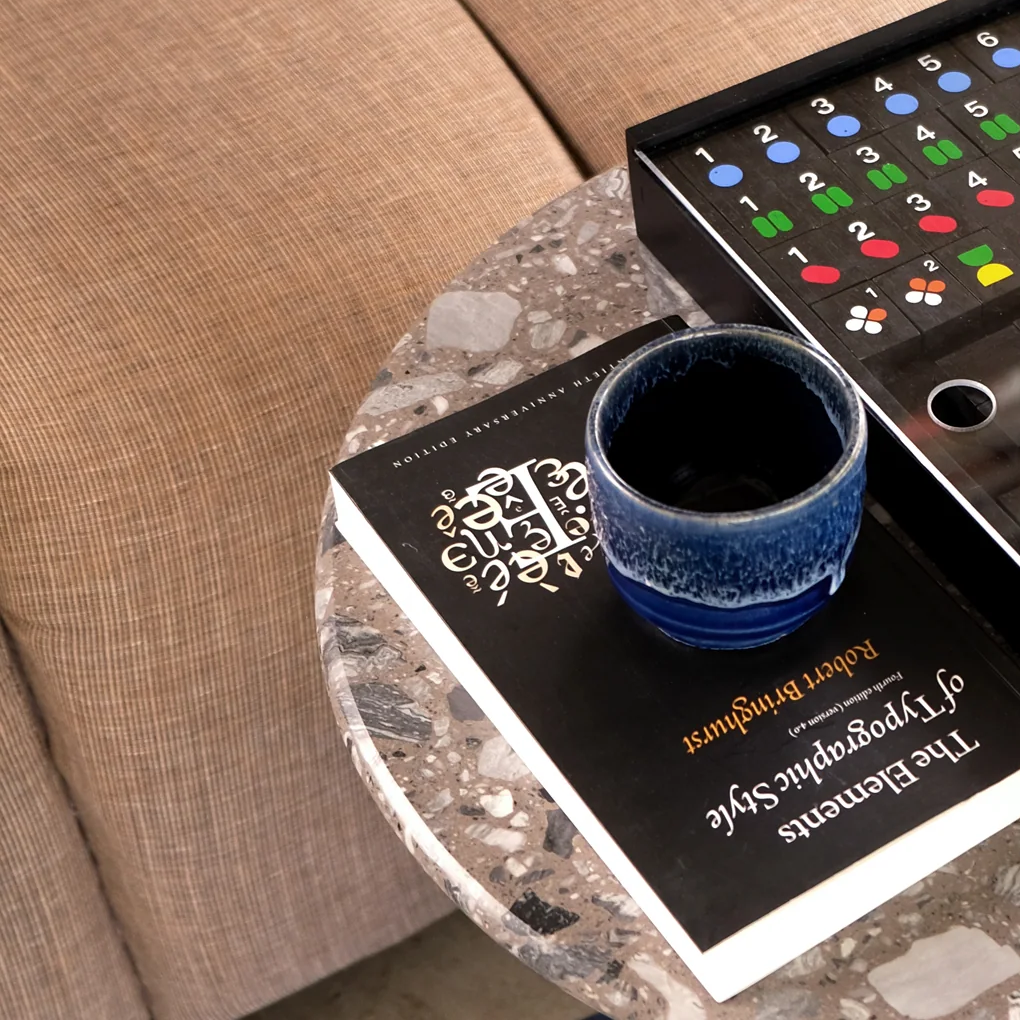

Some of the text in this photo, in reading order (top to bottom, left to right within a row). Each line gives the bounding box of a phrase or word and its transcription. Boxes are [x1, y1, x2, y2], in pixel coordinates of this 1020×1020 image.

[976, 31, 999, 48] 6
[917, 54, 942, 72] 5
[874, 76, 894, 93] 4
[810, 97, 835, 115] 3
[963, 99, 989, 118] 5
[753, 124, 779, 144] 2
[916, 124, 936, 142] 4
[695, 147, 715, 163] 1
[855, 145, 881, 164] 3
[798, 171, 826, 192] 2
[968, 170, 988, 188] 4
[739, 195, 759, 212] 1
[906, 193, 932, 212] 3
[847, 220, 876, 242] 2
[787, 246, 809, 264] 1
[923, 259, 940, 273] 2
[865, 286, 879, 299] 1
[465, 386, 565, 438] ANNIVERSARY
[393, 436, 458, 469] EDITION
[872, 671, 904, 693] Fourth
[682, 638, 880, 755] Robert Bringhurst
[843, 687, 873, 708] edition
[807, 703, 845, 726] (version
[705, 668, 965, 837] of Typographic Style
[777, 729, 981, 844] The Elements
